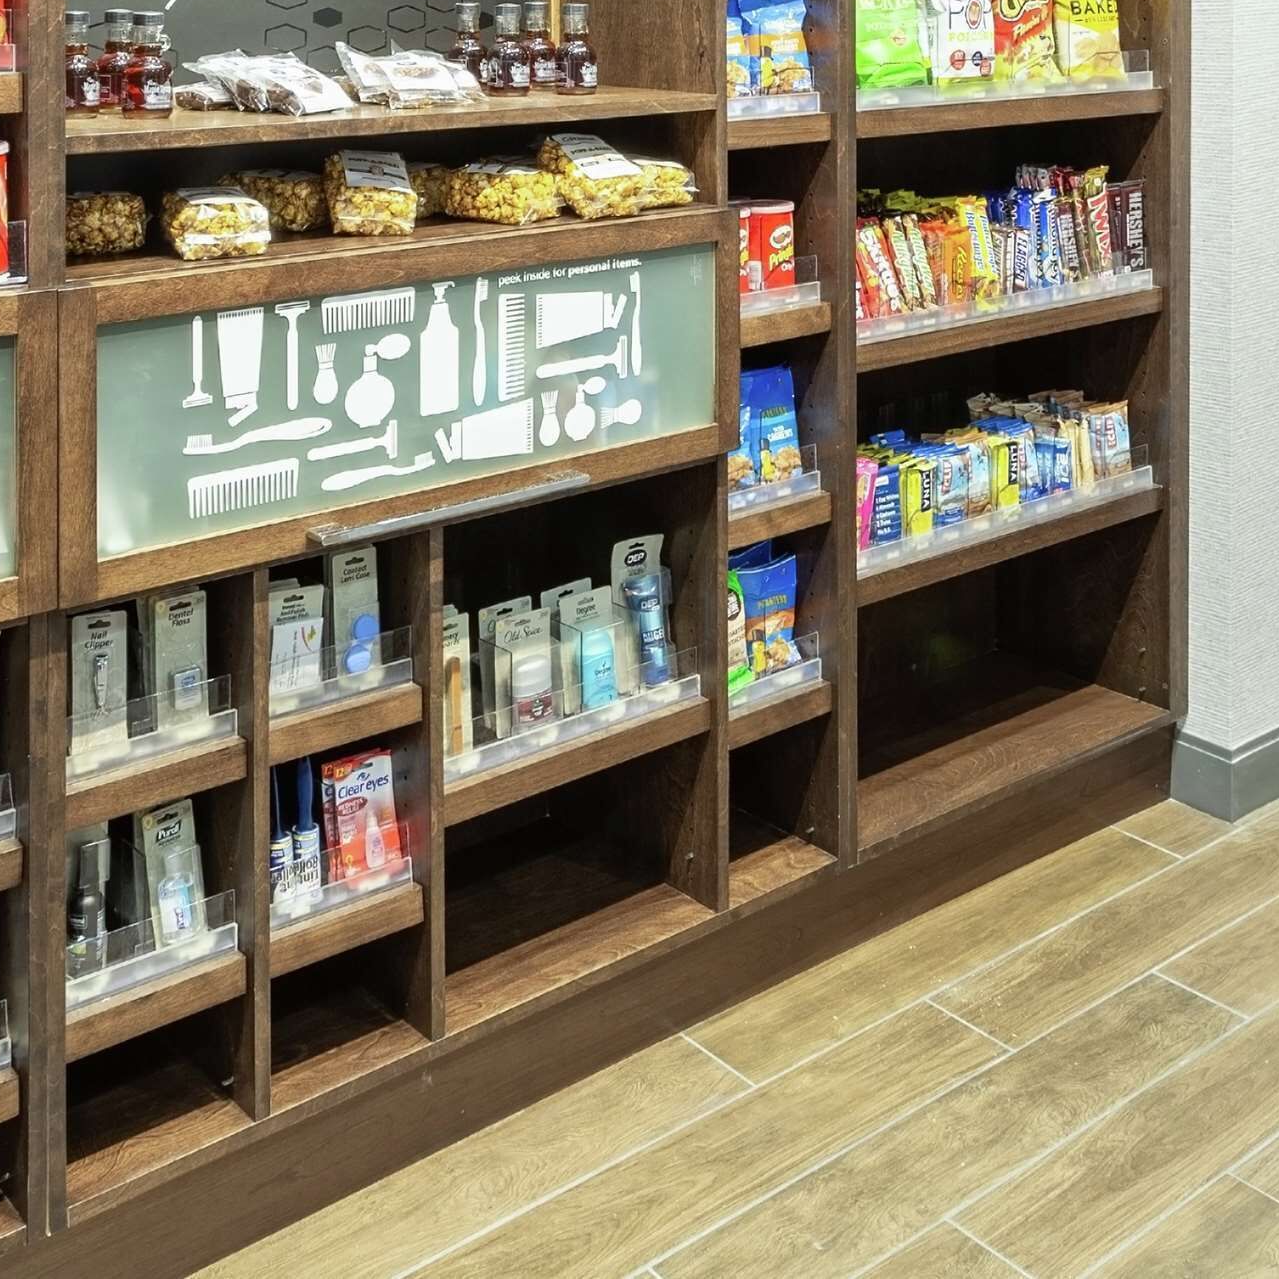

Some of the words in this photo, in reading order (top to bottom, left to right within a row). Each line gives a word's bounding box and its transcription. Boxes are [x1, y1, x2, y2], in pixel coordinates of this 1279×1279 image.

[1128, 192, 1146, 268] HERSHEY'S
[499, 271, 522, 288] peek
[523, 267, 551, 283] inside
[552, 267, 566, 279] for
[567, 259, 611, 279] personal
[612, 257, 642, 269] items.
[1009, 442, 1019, 484] LUNA
[921, 469, 931, 512] LUNA
[343, 564, 367, 576] Contact
[168, 608, 194, 622] Dental
[84, 637, 115, 651] Clipper
[90, 630, 108, 642] Nail
[504, 628, 521, 643] Old
[338, 782, 365, 800] Clear
[365, 774, 390, 793] eyes
